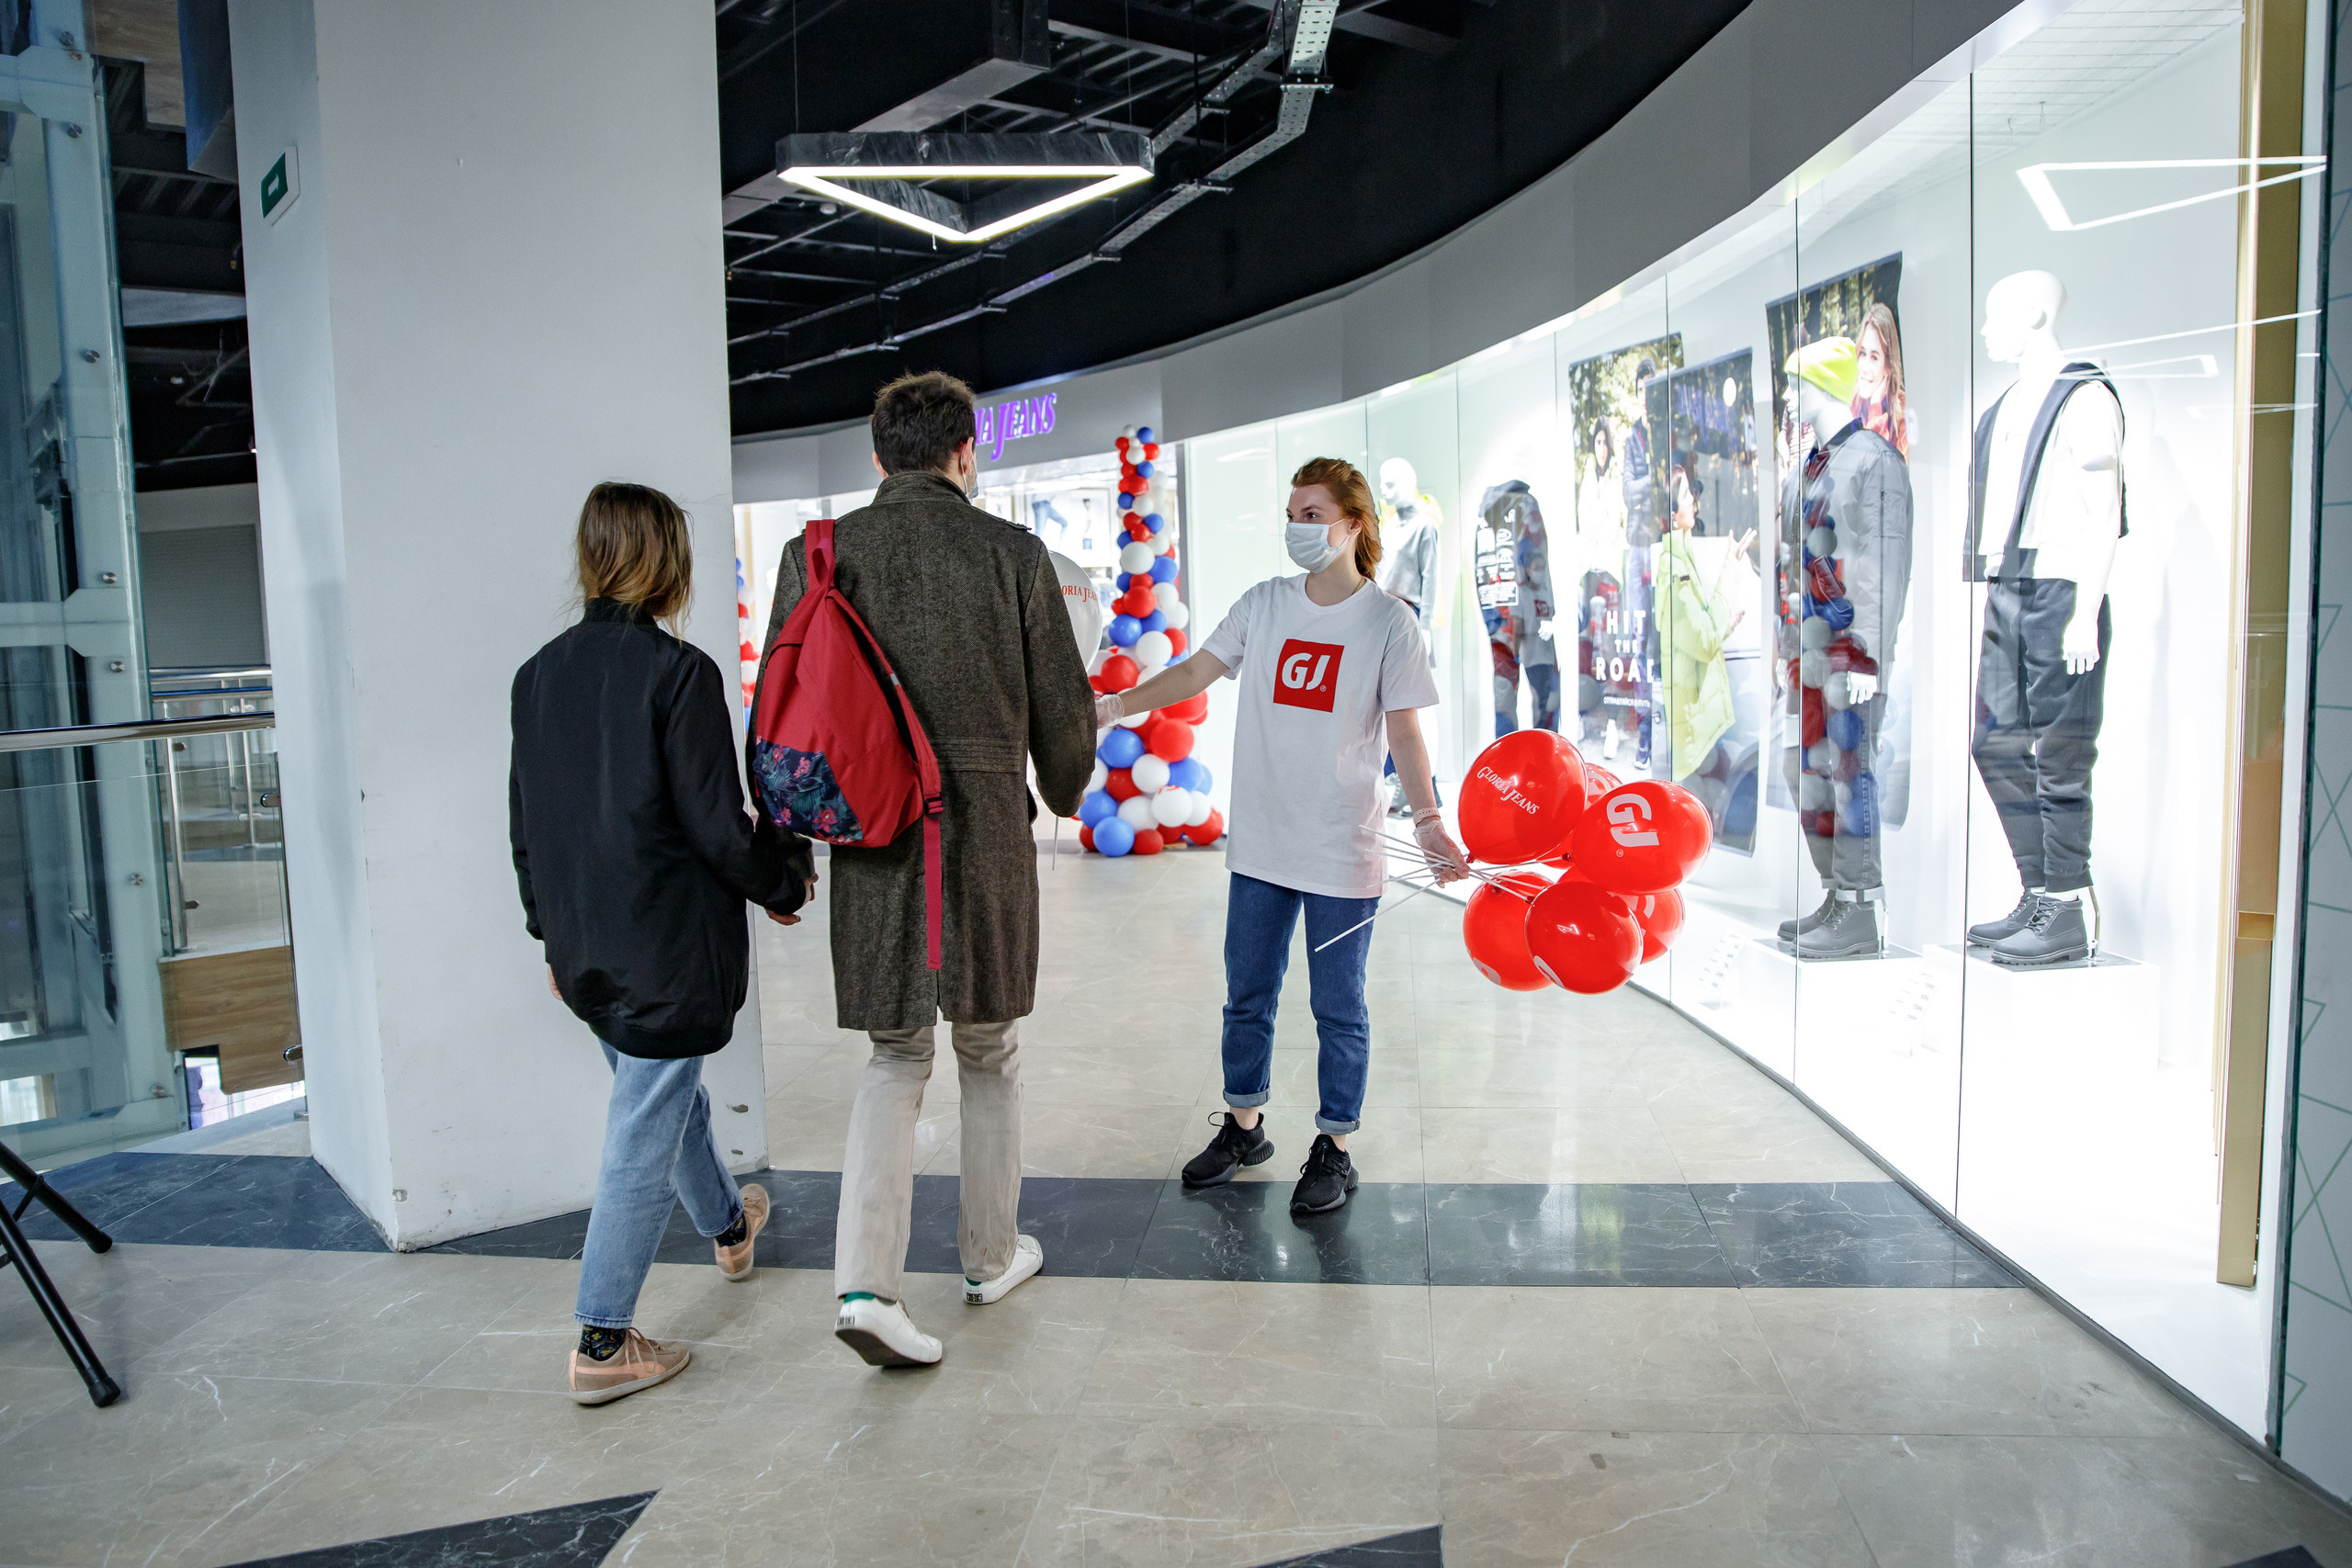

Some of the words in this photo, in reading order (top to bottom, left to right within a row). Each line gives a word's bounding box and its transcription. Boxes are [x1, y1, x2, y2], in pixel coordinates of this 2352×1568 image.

[990, 392, 1057, 461] JEANS
[1606, 610, 1646, 635] HIT
[1614, 639, 1639, 654] THE
[1281, 652, 1330, 691] GJ
[1476, 766, 1510, 795] GLORIA
[1500, 789, 1540, 815] JEANS
[1606, 793, 1660, 848] GJ
